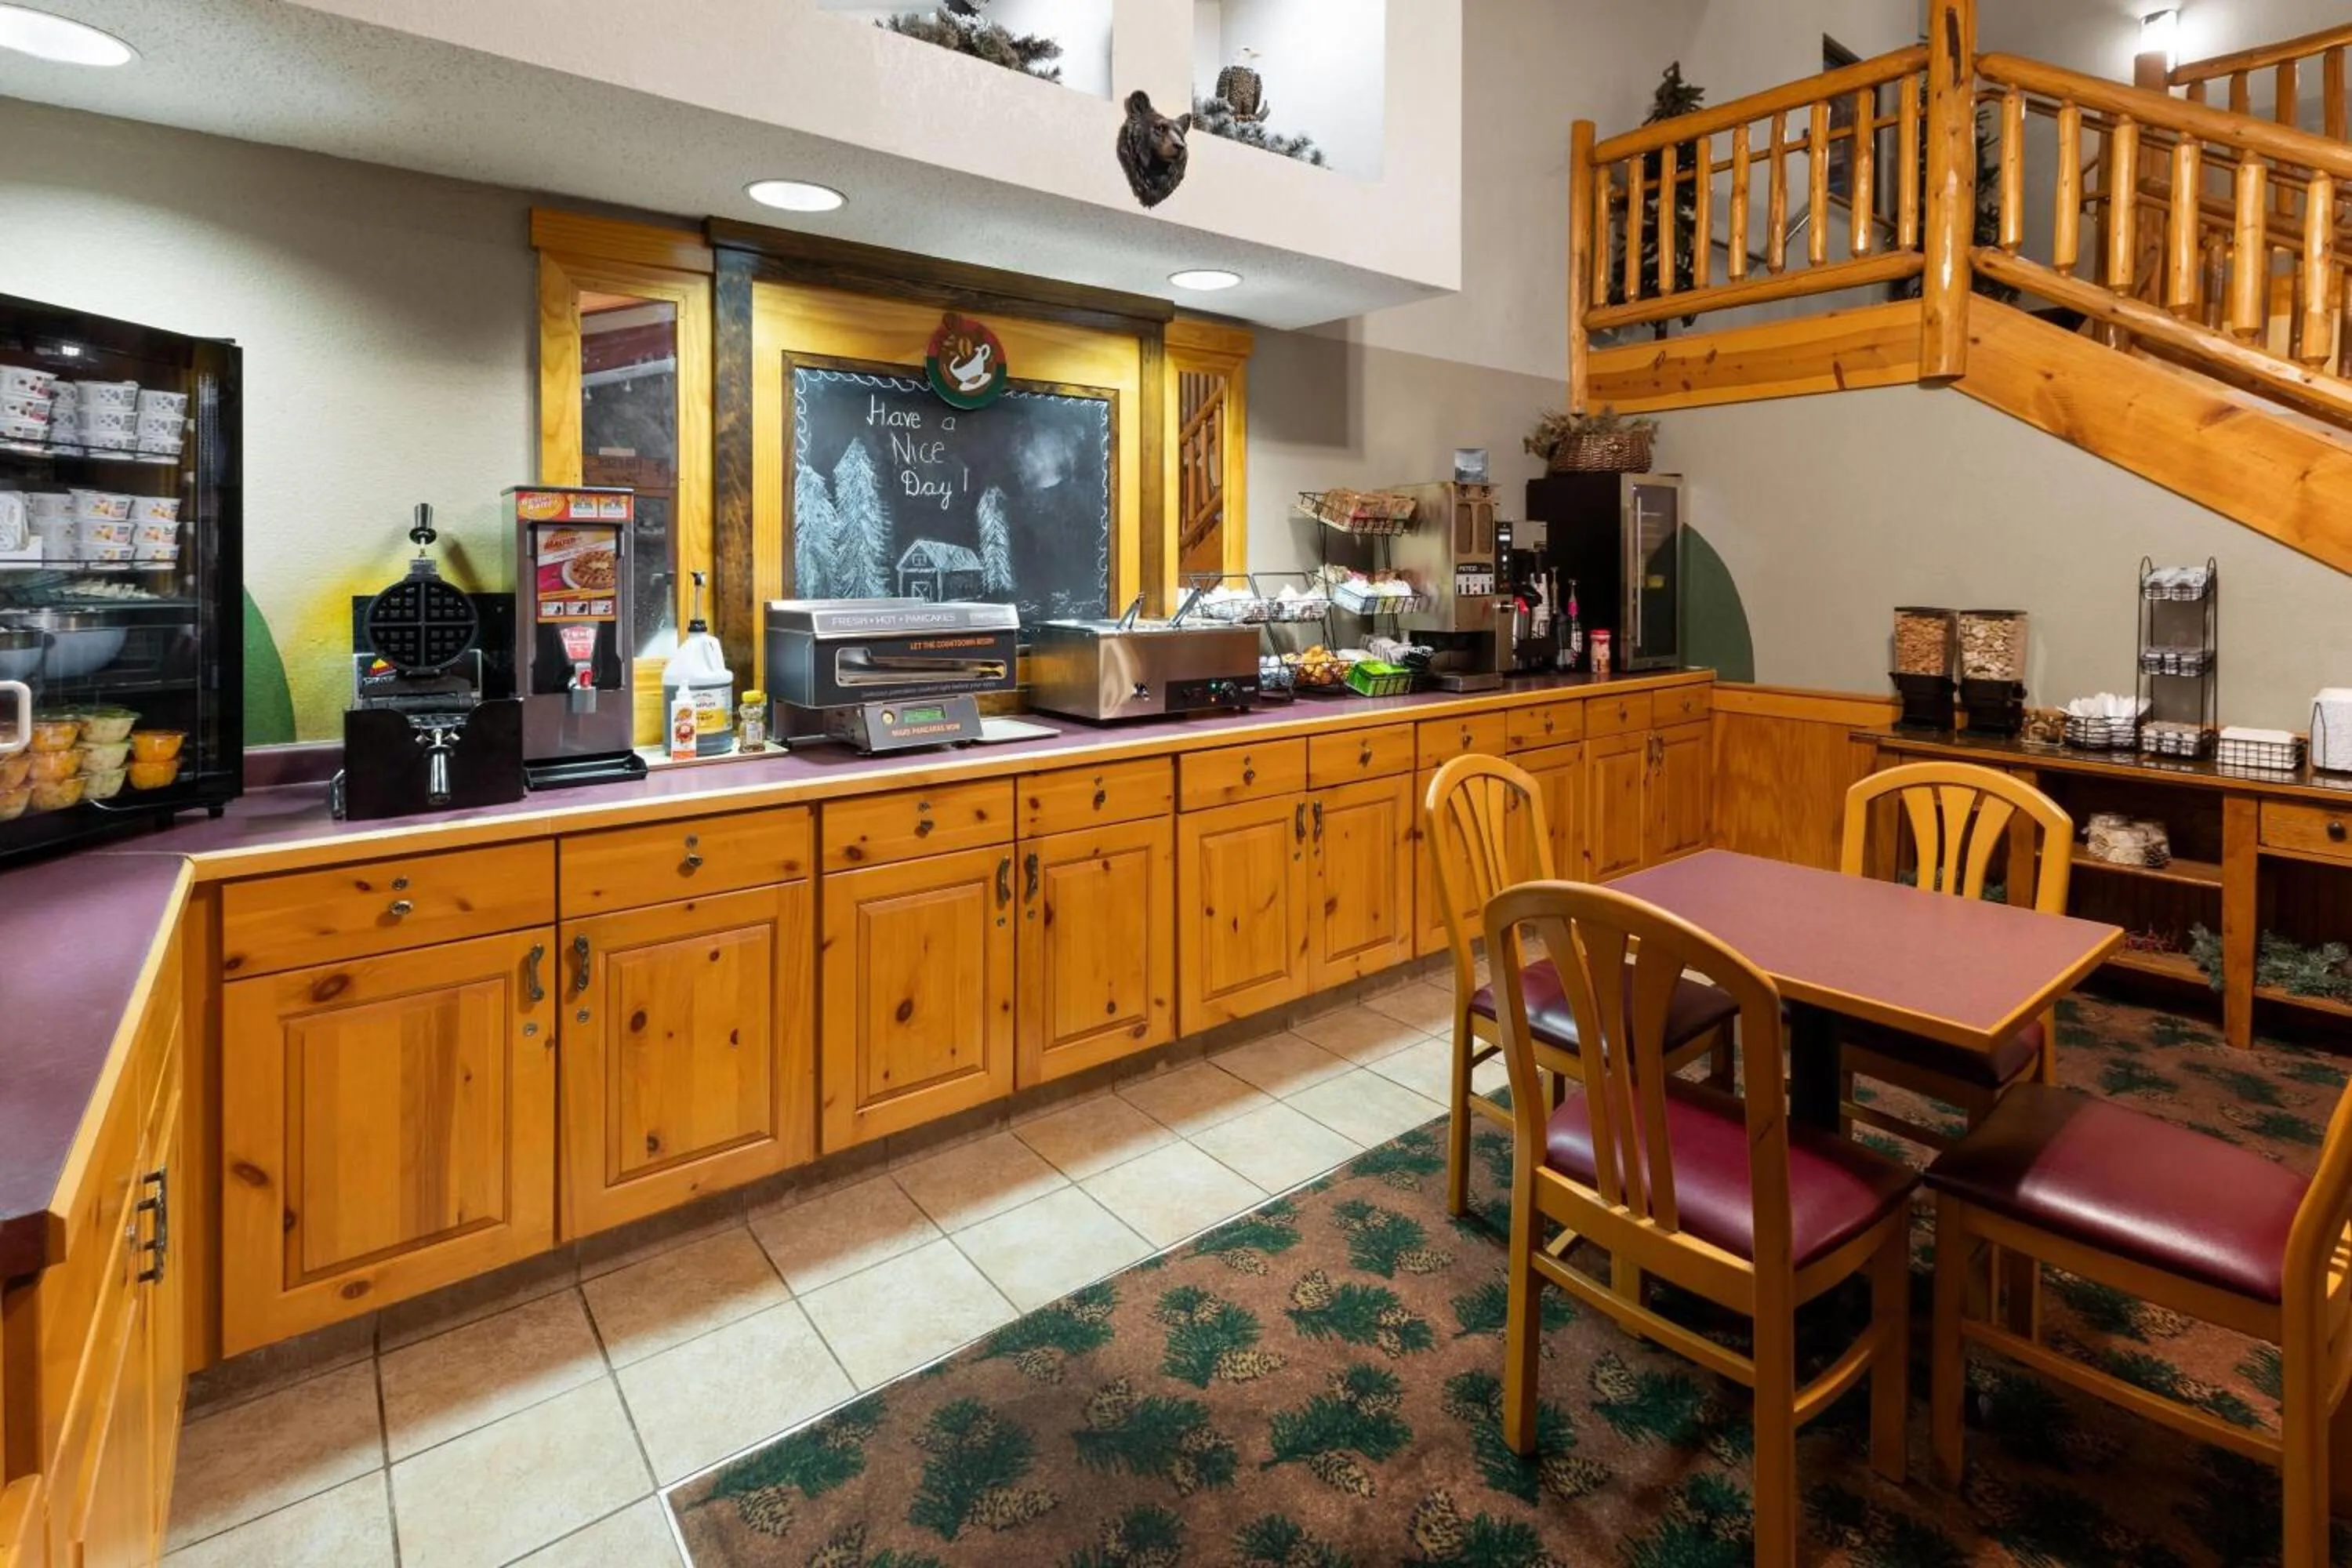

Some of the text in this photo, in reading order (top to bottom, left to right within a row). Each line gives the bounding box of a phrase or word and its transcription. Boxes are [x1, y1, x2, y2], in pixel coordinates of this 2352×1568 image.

[866, 394, 956, 430] Have a
[890, 431, 945, 465] Nice
[832, 613, 956, 626] FRESH HOT PANCAKES
[909, 641, 922, 651] LET
